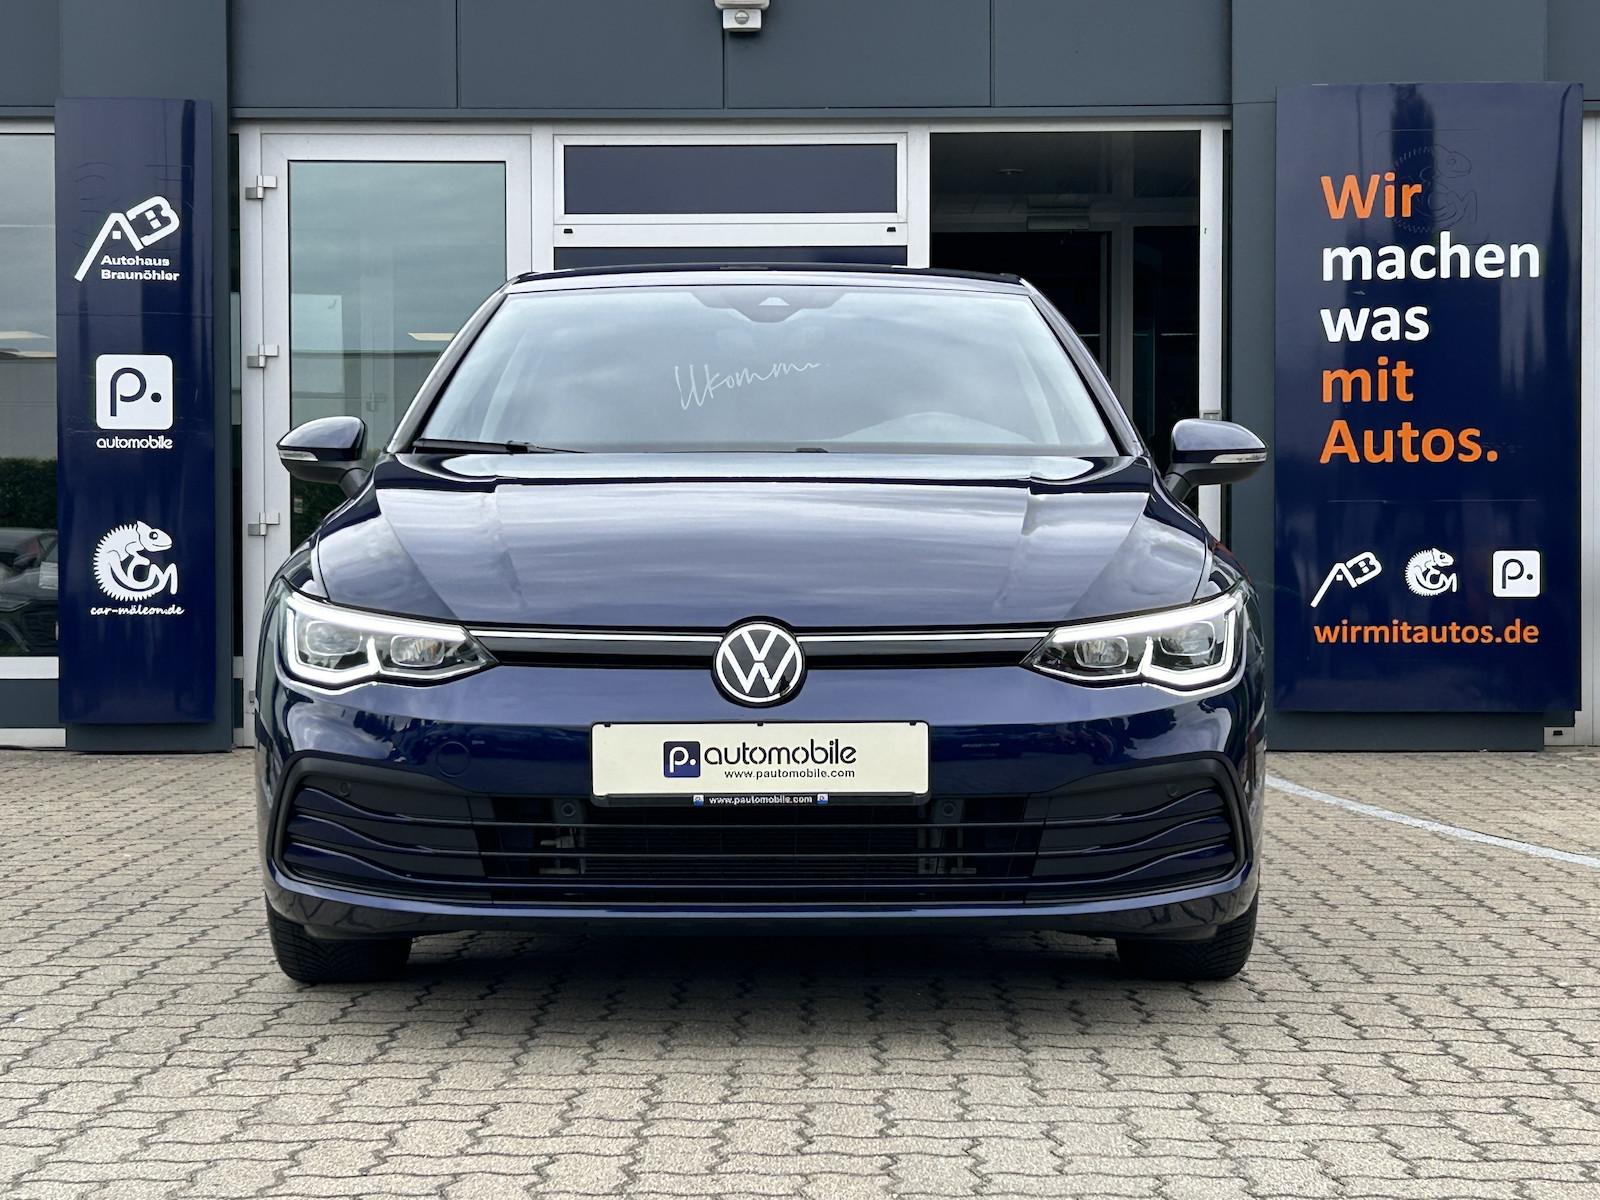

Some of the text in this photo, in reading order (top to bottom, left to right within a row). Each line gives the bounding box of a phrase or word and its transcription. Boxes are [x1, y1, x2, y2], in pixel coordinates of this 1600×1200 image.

[1320, 171, 1422, 220] Wir
[100, 254, 170, 267] Autohaus
[1322, 230, 1540, 282] machen
[100, 268, 180, 281] Braunöhler
[1319, 306, 1430, 343] was
[1322, 356, 1414, 403] mit
[96, 434, 173, 449] automobile
[1319, 419, 1498, 464] Autos.
[1314, 618, 1540, 644] wirmitautos.de
[704, 738, 857, 765] automobile
[724, 768, 855, 781] www.pautomobile.com
[708, 794, 813, 806] www.pautomobile.com
